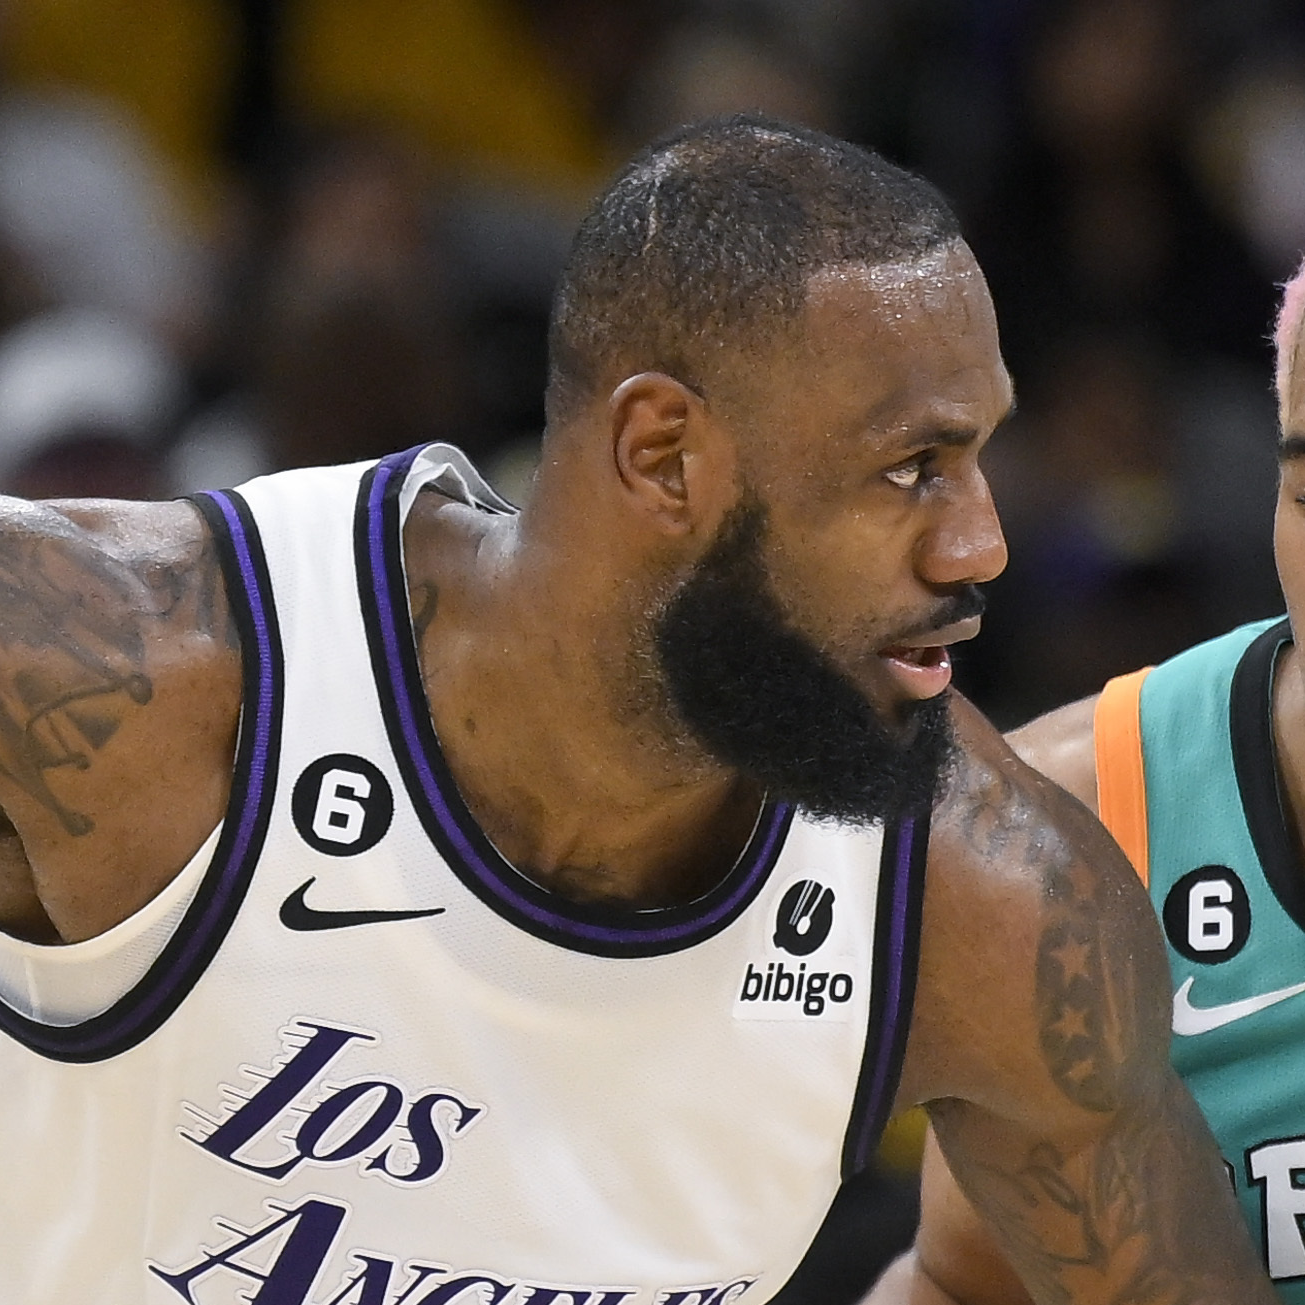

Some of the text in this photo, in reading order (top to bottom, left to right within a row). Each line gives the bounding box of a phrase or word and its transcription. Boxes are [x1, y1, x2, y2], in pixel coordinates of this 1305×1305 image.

[311, 768, 372, 844] 6
[1187, 879, 1233, 951] 6
[740, 962, 854, 1017] bibigo
